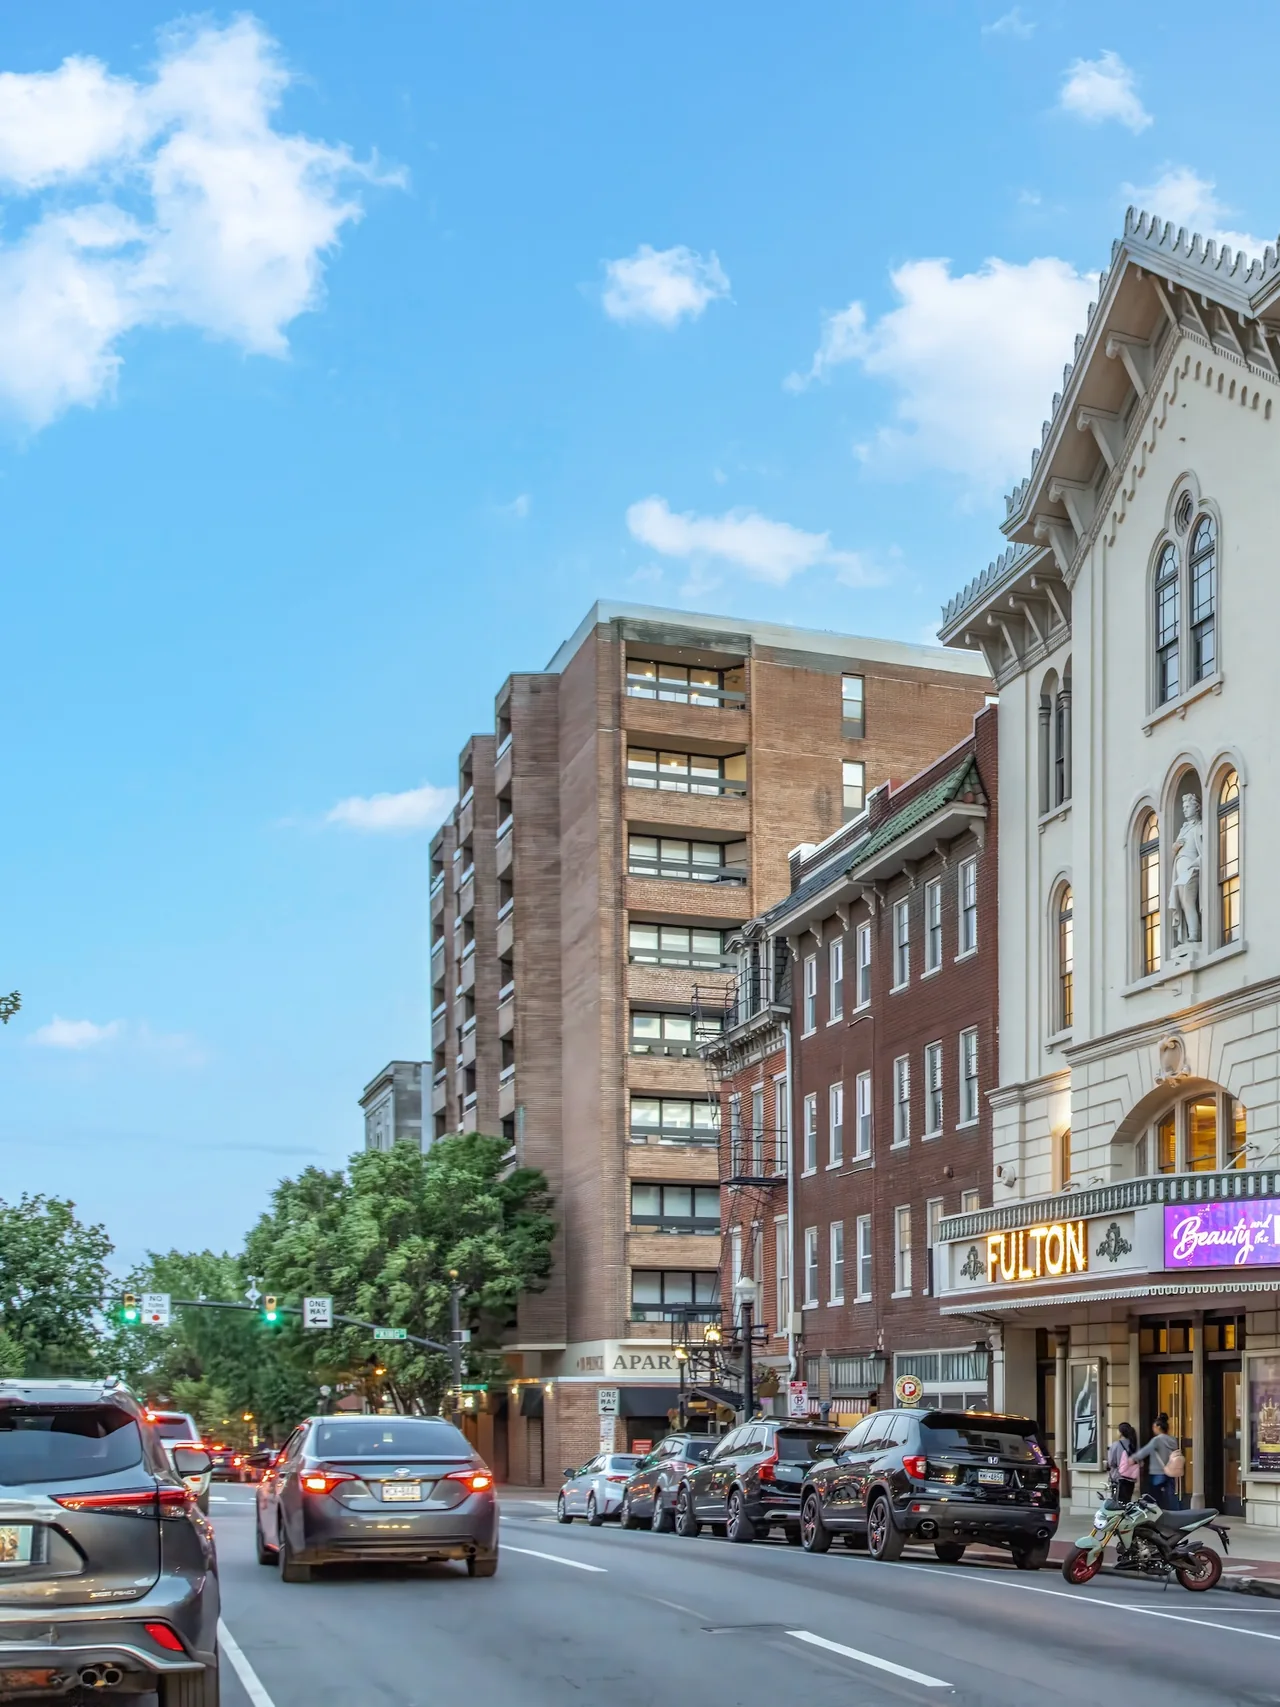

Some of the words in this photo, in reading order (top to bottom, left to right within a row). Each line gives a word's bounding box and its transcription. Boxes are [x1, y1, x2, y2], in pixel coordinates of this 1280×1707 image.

[1250, 1214, 1272, 1229] and
[1173, 1215, 1254, 1265] Beauty
[1254, 1229, 1269, 1244] the
[987, 1220, 1088, 1283] FULTON
[904, 1383, 916, 1395] P
